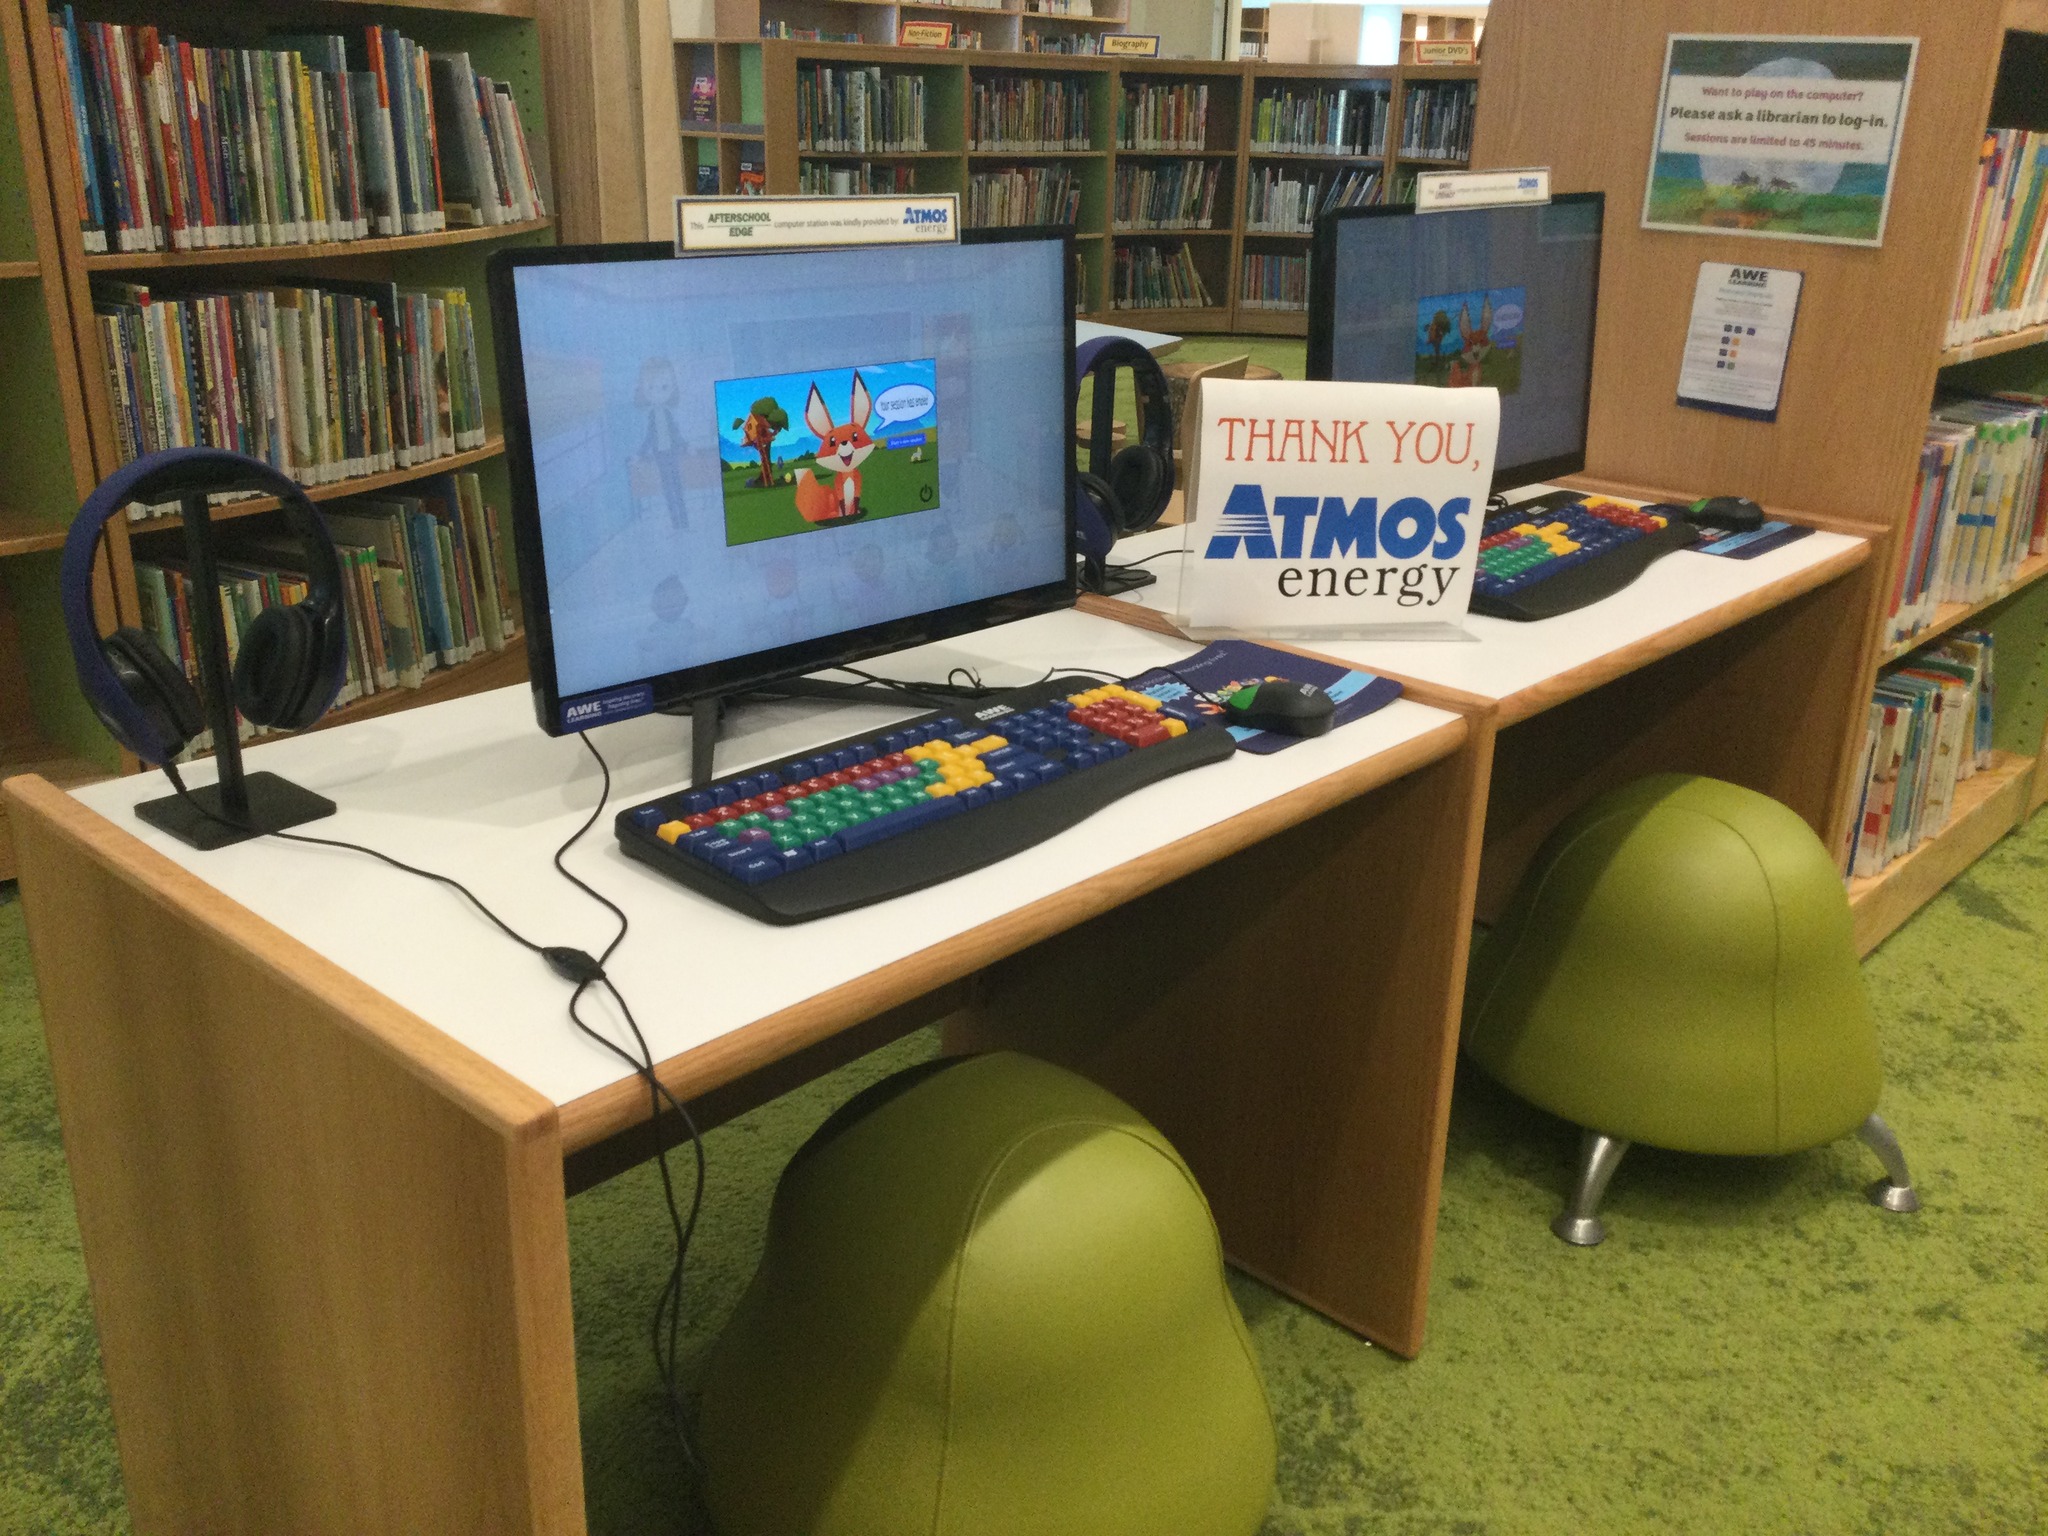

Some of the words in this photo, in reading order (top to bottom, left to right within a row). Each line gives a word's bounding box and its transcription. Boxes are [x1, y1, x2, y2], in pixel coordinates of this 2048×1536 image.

[908, 28, 942, 39] Non-Fiction
[1111, 38, 1149, 50] Biography
[1422, 47, 1446, 55] Junior
[1447, 46, 1468, 55] DVD's
[1702, 86, 1728, 97] Want
[1731, 87, 1742, 97] to
[1744, 88, 1768, 100] play
[1770, 90, 1783, 98] on
[1787, 89, 1803, 99] the
[1806, 91, 1864, 102] computer?
[1669, 106, 1715, 120] Please
[1718, 109, 1742, 121] ask
[1745, 112, 1754, 121] a
[1756, 109, 1819, 124] librarian
[1822, 113, 1836, 125] to
[1839, 112, 1888, 130] log-in.
[1684, 132, 1728, 144] Sessions
[1730, 136, 1747, 144] are
[1749, 135, 1787, 146] limited
[1789, 138, 1800, 147] to
[1803, 138, 1817, 148] 45
[708, 212, 771, 223] AFTERSCHOOL
[903, 207, 947, 224] ATMOS
[690, 222, 704, 230] This
[774, 221, 805, 229] computer
[806, 219, 829, 227] station
[862, 217, 889, 227] provided
[890, 217, 899, 227] by
[915, 222, 947, 235] energy
[729, 227, 753, 237] EDGE
[1730, 268, 1768, 282] AWE
[1218, 418, 1369, 463] THANK
[1386, 421, 1480, 471] YOU,
[1204, 484, 1471, 560] ATMOS
[1277, 563, 1460, 607] energy
[567, 701, 602, 718] AWE
